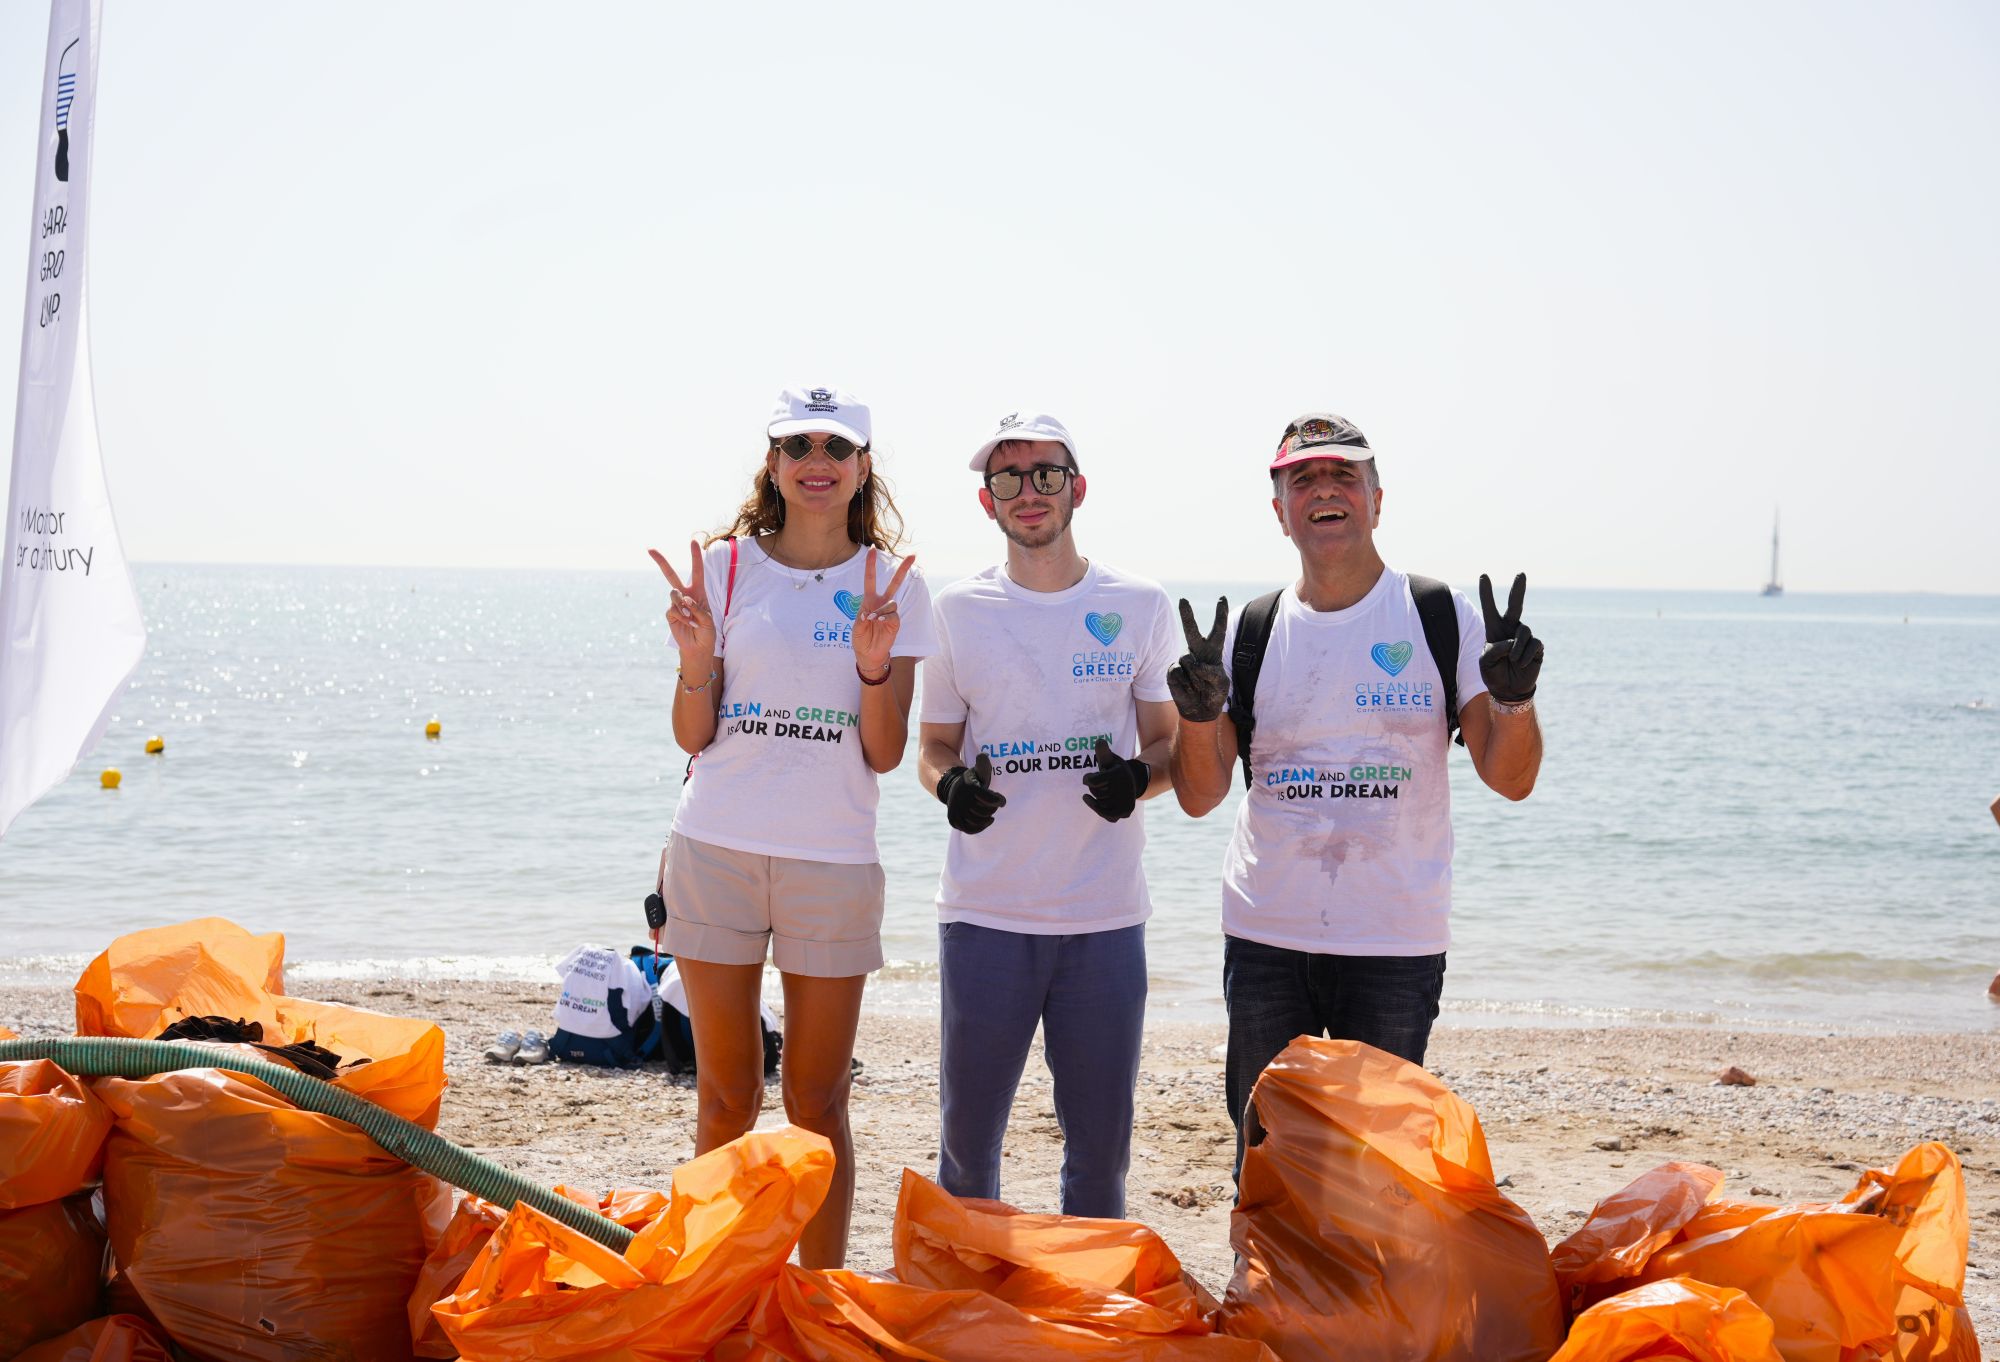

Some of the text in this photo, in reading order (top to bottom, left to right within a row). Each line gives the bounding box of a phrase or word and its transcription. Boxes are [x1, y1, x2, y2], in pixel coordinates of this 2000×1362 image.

[815, 621, 853, 631] CLEA
[813, 631, 851, 643] GRE
[1072, 651, 1117, 665] CLEAN
[1072, 663, 1132, 677] GREECE
[1355, 681, 1433, 694] CLEAN UP
[1355, 694, 1432, 706] GREECE
[763, 708, 791, 719] AND
[795, 706, 858, 728] GREEN
[727, 719, 843, 744] IS OUR DREAM
[1037, 743, 1061, 754] AND
[1064, 732, 1113, 751] GREN
[992, 766, 1003, 776] IS
[1005, 758, 1043, 774] OUR
[1267, 766, 1412, 786] CLEAN AND GREEN
[1278, 784, 1398, 801] IS OUR DREAM
